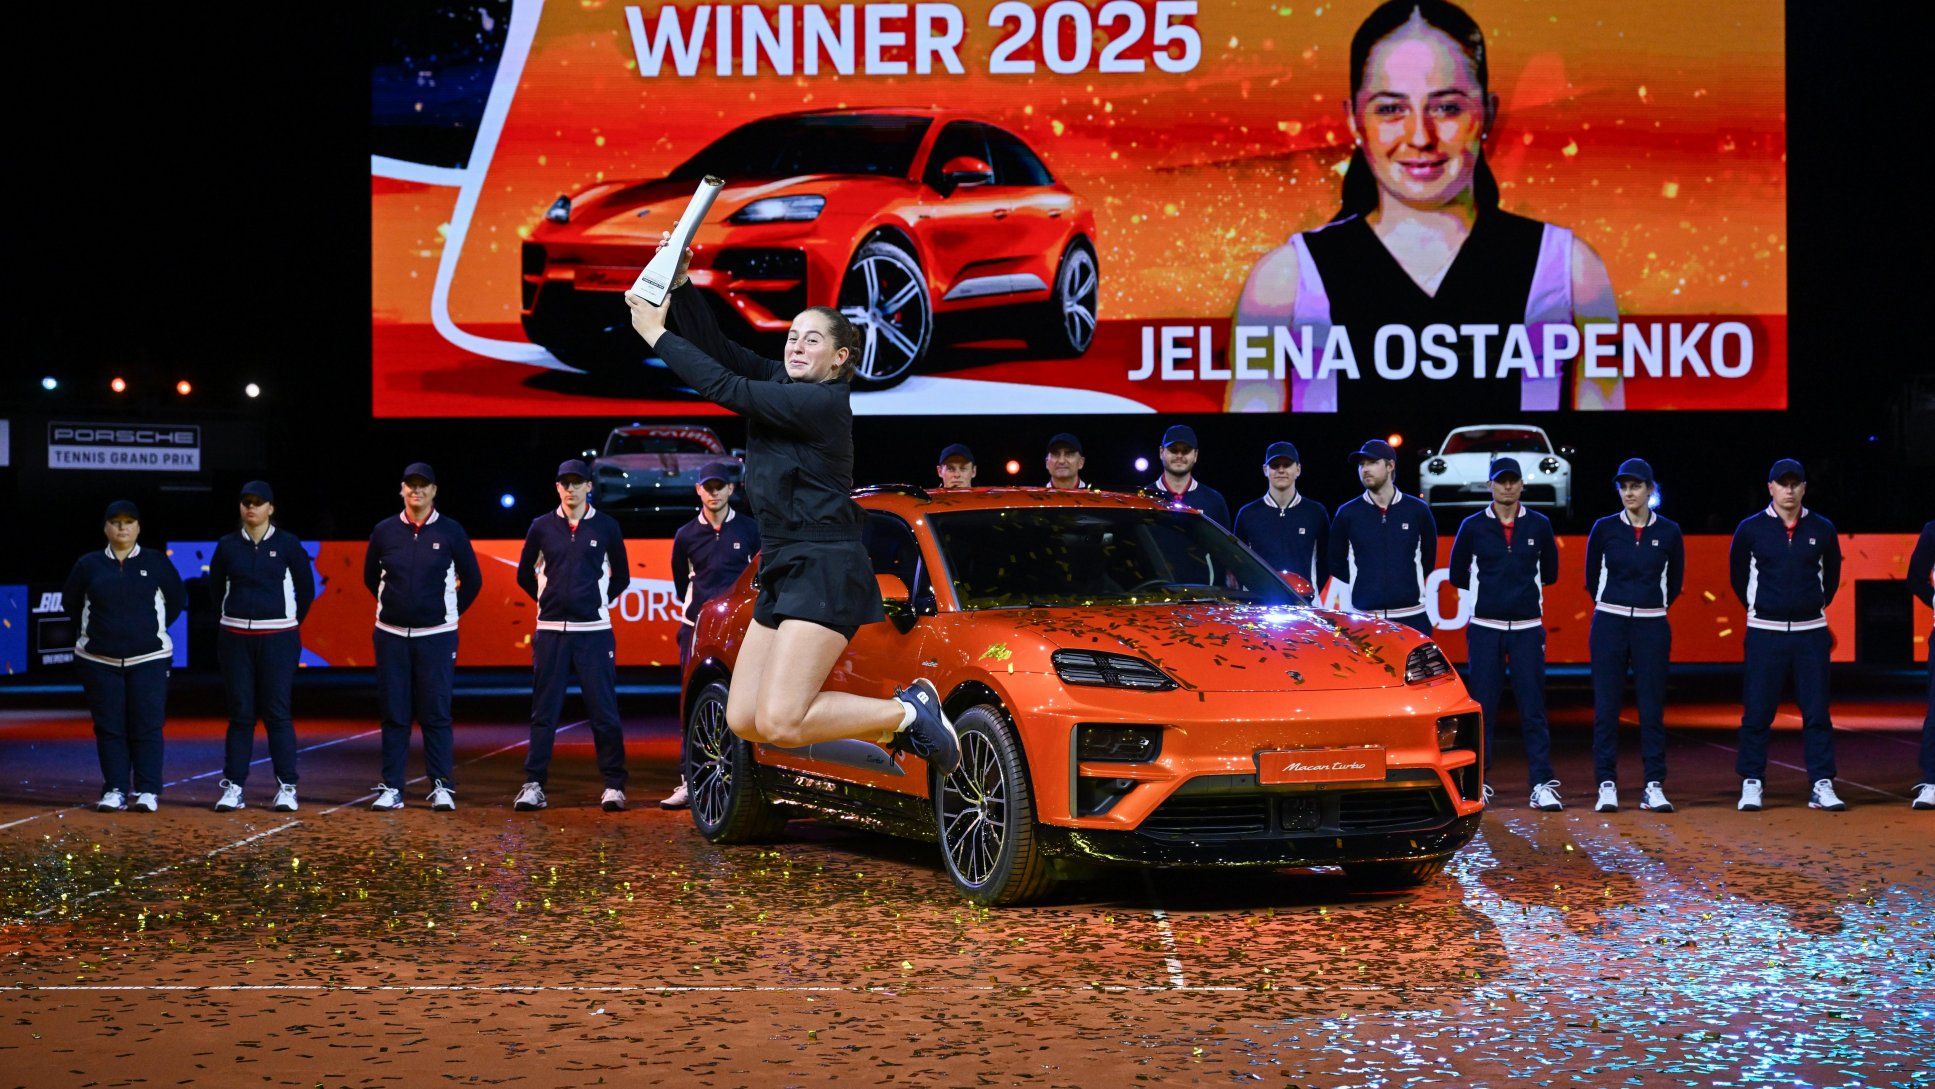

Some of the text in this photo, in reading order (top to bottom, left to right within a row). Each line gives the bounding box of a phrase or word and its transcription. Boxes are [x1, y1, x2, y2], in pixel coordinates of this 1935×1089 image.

[624, 0, 1202, 77] WINNER 2025
[1128, 322, 1754, 381] JELENA OSTAPENKO
[54, 428, 194, 444] PORSCHE
[55, 451, 194, 466] TENNIS GRAND PRIX
[1282, 762, 1330, 772] Macan
